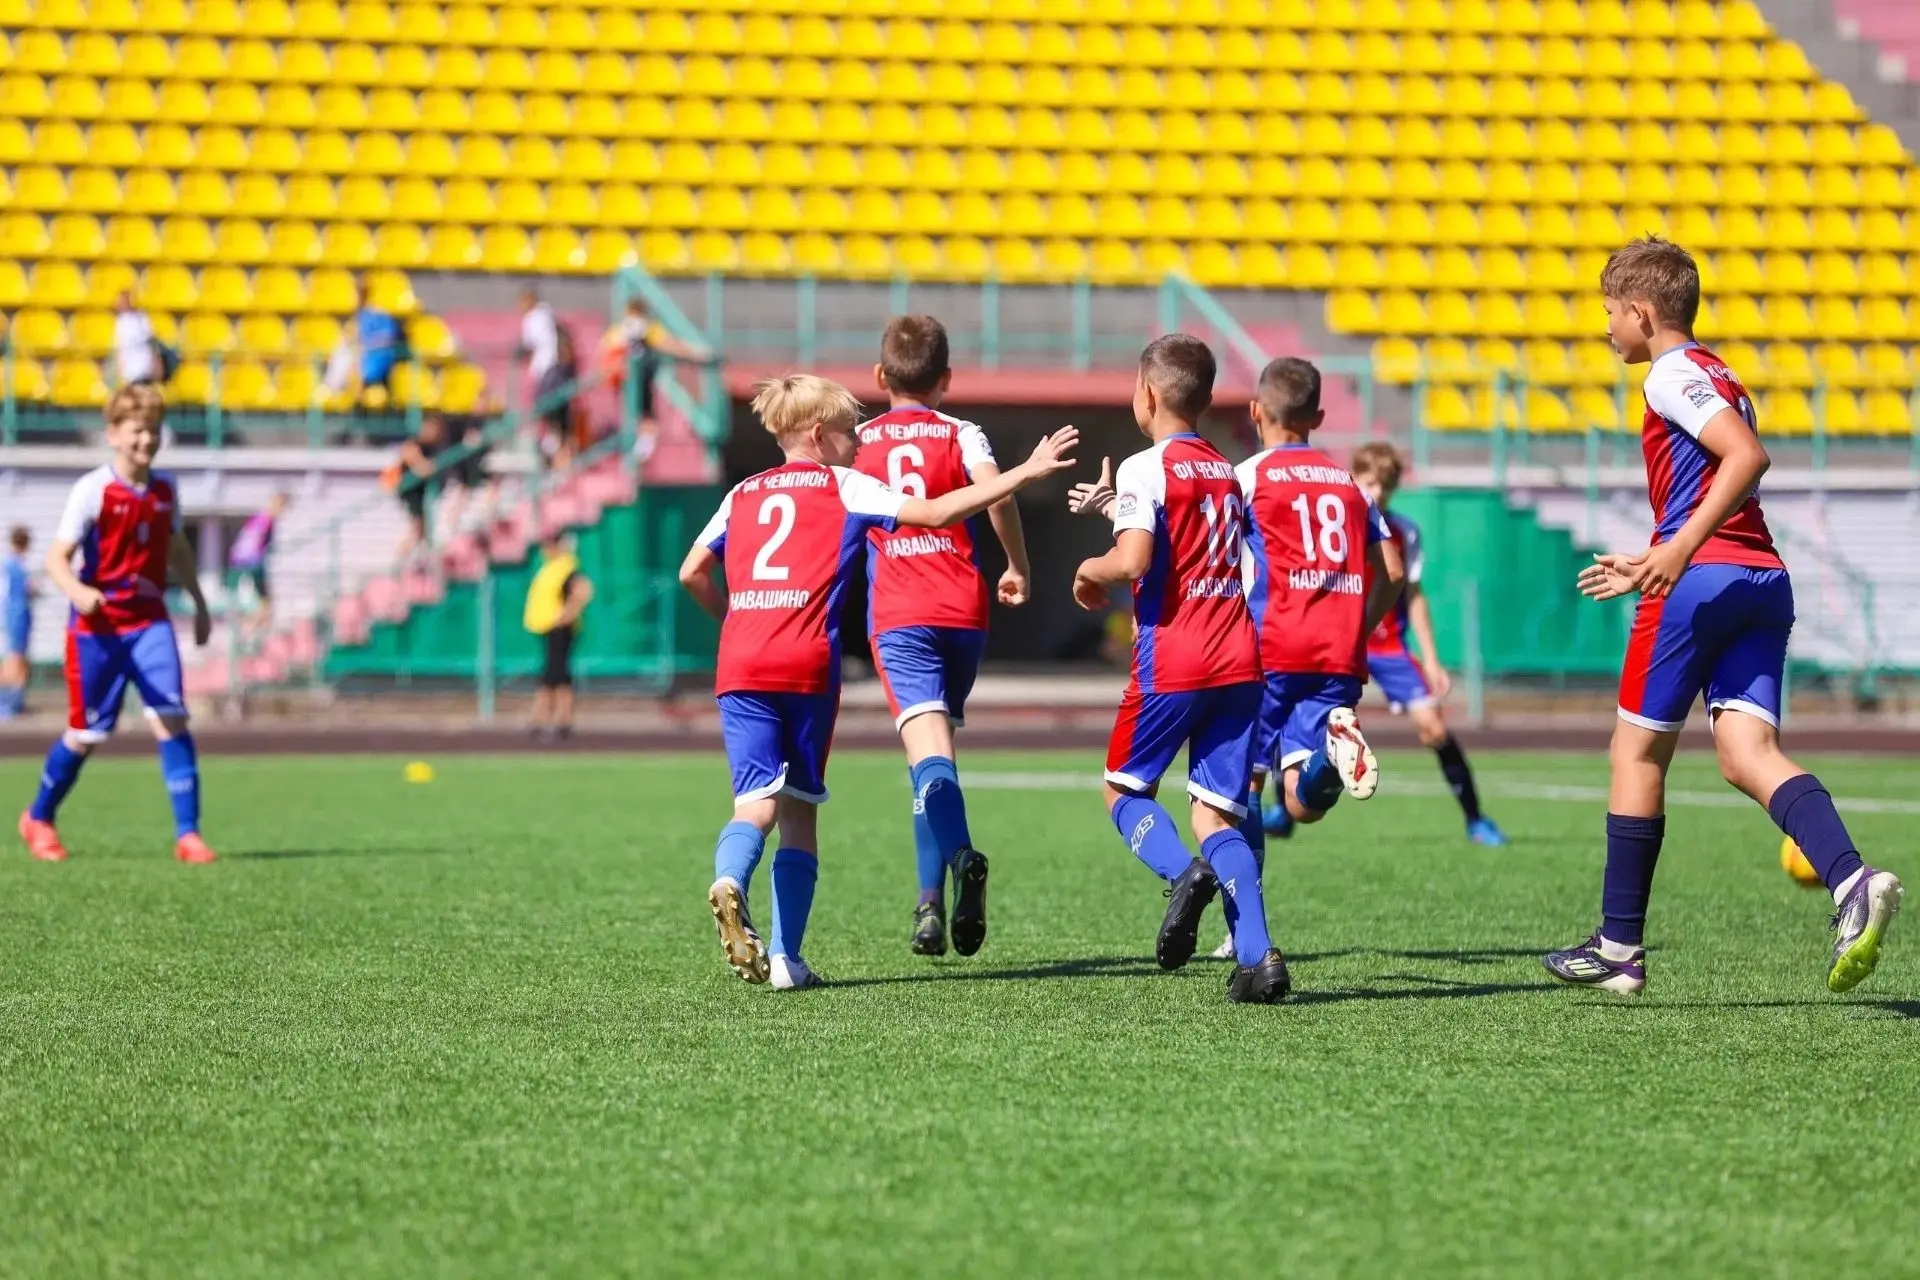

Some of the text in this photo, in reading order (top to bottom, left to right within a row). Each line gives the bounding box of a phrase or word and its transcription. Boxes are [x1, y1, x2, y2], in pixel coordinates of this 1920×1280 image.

[861, 422, 951, 443] ФК ЧЕМПИОН
[764, 471, 829, 490] ЧЕМПИОН
[887, 443, 926, 500] 6
[1172, 460, 1197, 480] ФК
[1266, 465, 1354, 488] ФК ЧЕМПИОН
[752, 493, 796, 581] 2
[1291, 493, 1348, 563] 18
[1289, 569, 1363, 595] НАВАШИНО
[731, 590, 810, 611] НАВАШИНО
